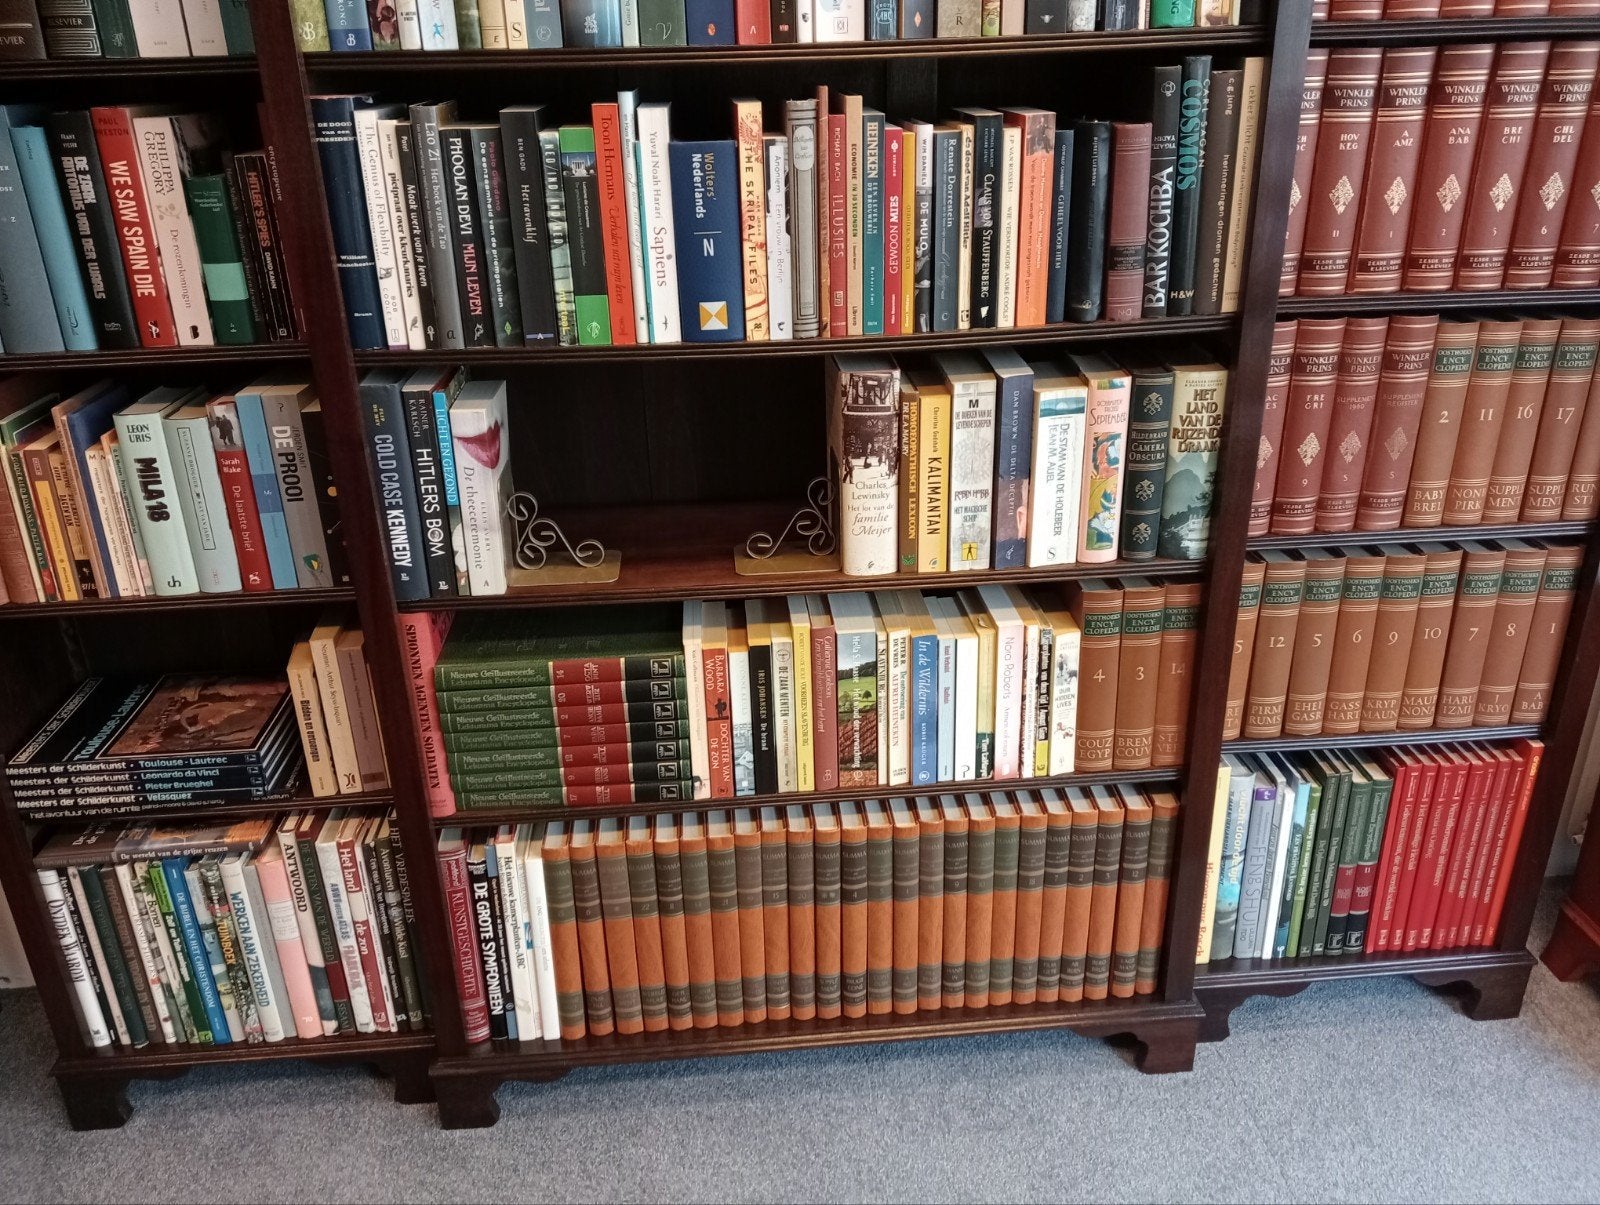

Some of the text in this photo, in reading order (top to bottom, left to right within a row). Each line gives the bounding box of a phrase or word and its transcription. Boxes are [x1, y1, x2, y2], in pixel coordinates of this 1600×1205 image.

[1340, 98, 1368, 107] PRINS
[1396, 97, 1422, 105] PRINS
[1451, 95, 1479, 103] PRINS
[1507, 94, 1534, 102] PRINS
[1198, 78, 1211, 168] CARL SAGAN
[425, 121, 436, 145] Lao
[1176, 79, 1203, 191] COSMOS
[1502, 135, 1521, 144] CHI
[1553, 135, 1572, 143] DEL
[1339, 142, 1358, 150] KEG
[1393, 138, 1413, 147] AMZ
[1448, 136, 1470, 145] BAB
[428, 148, 440, 161] Zi
[600, 115, 616, 201] Toon Hermans
[948, 138, 957, 174] Renate
[144, 132, 165, 196] GREGORY
[155, 132, 174, 193] PHILIPPA
[650, 131, 662, 219] Yuval Noah Harari
[704, 153, 716, 200] Wolters'
[450, 137, 472, 235] PHOOLAN DEVI
[692, 153, 706, 219] Nederlands
[946, 175, 957, 228] Dorrestein
[744, 147, 758, 285] THE SKRIPAL FILES
[109, 160, 156, 297] WE SAW SPAIN DIE
[832, 194, 844, 259] ILLUSIES
[919, 201, 929, 251] DE MULO
[407, 184, 427, 287] Maak werk van je leven
[889, 195, 899, 274] GEWOON MIES
[1144, 166, 1174, 308] BAR KOCHBA
[703, 238, 715, 257] N
[650, 226, 670, 288] Sapiens
[462, 243, 482, 315] MIJN LEVEN
[1170, 290, 1195, 299] H&W
[1193, 388, 1216, 401] HET
[1186, 401, 1219, 414] LAND
[1516, 403, 1533, 419] 16
[1090, 408, 1128, 427] SEPTEMBER
[1179, 414, 1222, 428] VAN DE
[1439, 410, 1450, 423] 2
[1555, 407, 1575, 425] 17
[126, 424, 150, 434] LEON
[1131, 431, 1168, 440] HILDEBRAND
[129, 433, 152, 443] URIS
[1131, 442, 1165, 452] CAMERA
[221, 458, 240, 466] Sarah
[436, 408, 457, 503] LICHT EN GEZOND
[1129, 452, 1165, 461] OBSCURA
[272, 425, 304, 503] DE PROOI
[134, 457, 170, 522] MILA 18
[855, 482, 887, 490] Charles
[374, 434, 413, 568] COLD CASE KENNEDY
[852, 491, 890, 500] Lewinsky
[927, 457, 942, 535] KALIMANTAN
[1414, 489, 1445, 500] BABY
[416, 448, 446, 557] HITLERS BOM
[1455, 499, 1482, 510] PIRK
[232, 485, 254, 552] De laatste brief
[464, 467, 483, 570] De theeceremonie
[853, 513, 889, 524] familie
[851, 526, 892, 537] Meijer
[1352, 629, 1362, 643] 6
[1423, 628, 1442, 640] 10
[1469, 627, 1480, 641] 7
[1506, 623, 1516, 636] 8
[1269, 636, 1286, 648] 12
[1312, 633, 1321, 647] 5
[1388, 631, 1398, 646] 9
[704, 659, 714, 691] WOOD
[715, 654, 725, 693] BARBARA
[919, 640, 931, 716] In de Wildernis
[1094, 669, 1105, 682] 4
[1136, 667, 1144, 680] 3
[1533, 691, 1543, 700] A
[1250, 704, 1282, 715] PIRM
[1329, 700, 1361, 710] GASS
[1366, 699, 1397, 709] KRYP
[1401, 704, 1435, 717] NONA
[1442, 705, 1472, 715] IZMI
[1478, 703, 1509, 713] KRYO
[1521, 700, 1543, 710] BAB
[1249, 715, 1280, 725] RUMS
[1291, 711, 1321, 721] GASR
[1328, 710, 1361, 720] HART
[1361, 709, 1398, 720] MAUN
[1078, 738, 1113, 748] COUZ
[1118, 736, 1151, 746] BREM
[710, 737, 719, 769] DE ZON
[720, 723, 730, 782] DOCHTER VAN
[1080, 749, 1111, 758] EGYP
[6, 764, 48, 775] Meesters
[50, 764, 65, 772] der
[67, 761, 127, 771] Schilderkunst
[139, 758, 183, 768] Toulouse
[190, 756, 228, 765] Lautrec
[10, 769, 220, 786] Meesters der Schilderkunst Leonardo da Vinci
[14, 780, 214, 797] Meesters der Schilderkunst Pieter Brueghel
[340, 847, 360, 893] Het land
[284, 844, 308, 912] ANTWOORD
[473, 881, 488, 900] DE
[476, 901, 494, 940] GROTE
[355, 921, 369, 955] de zon
[451, 891, 476, 997] KUNSTGESCHICHTE
